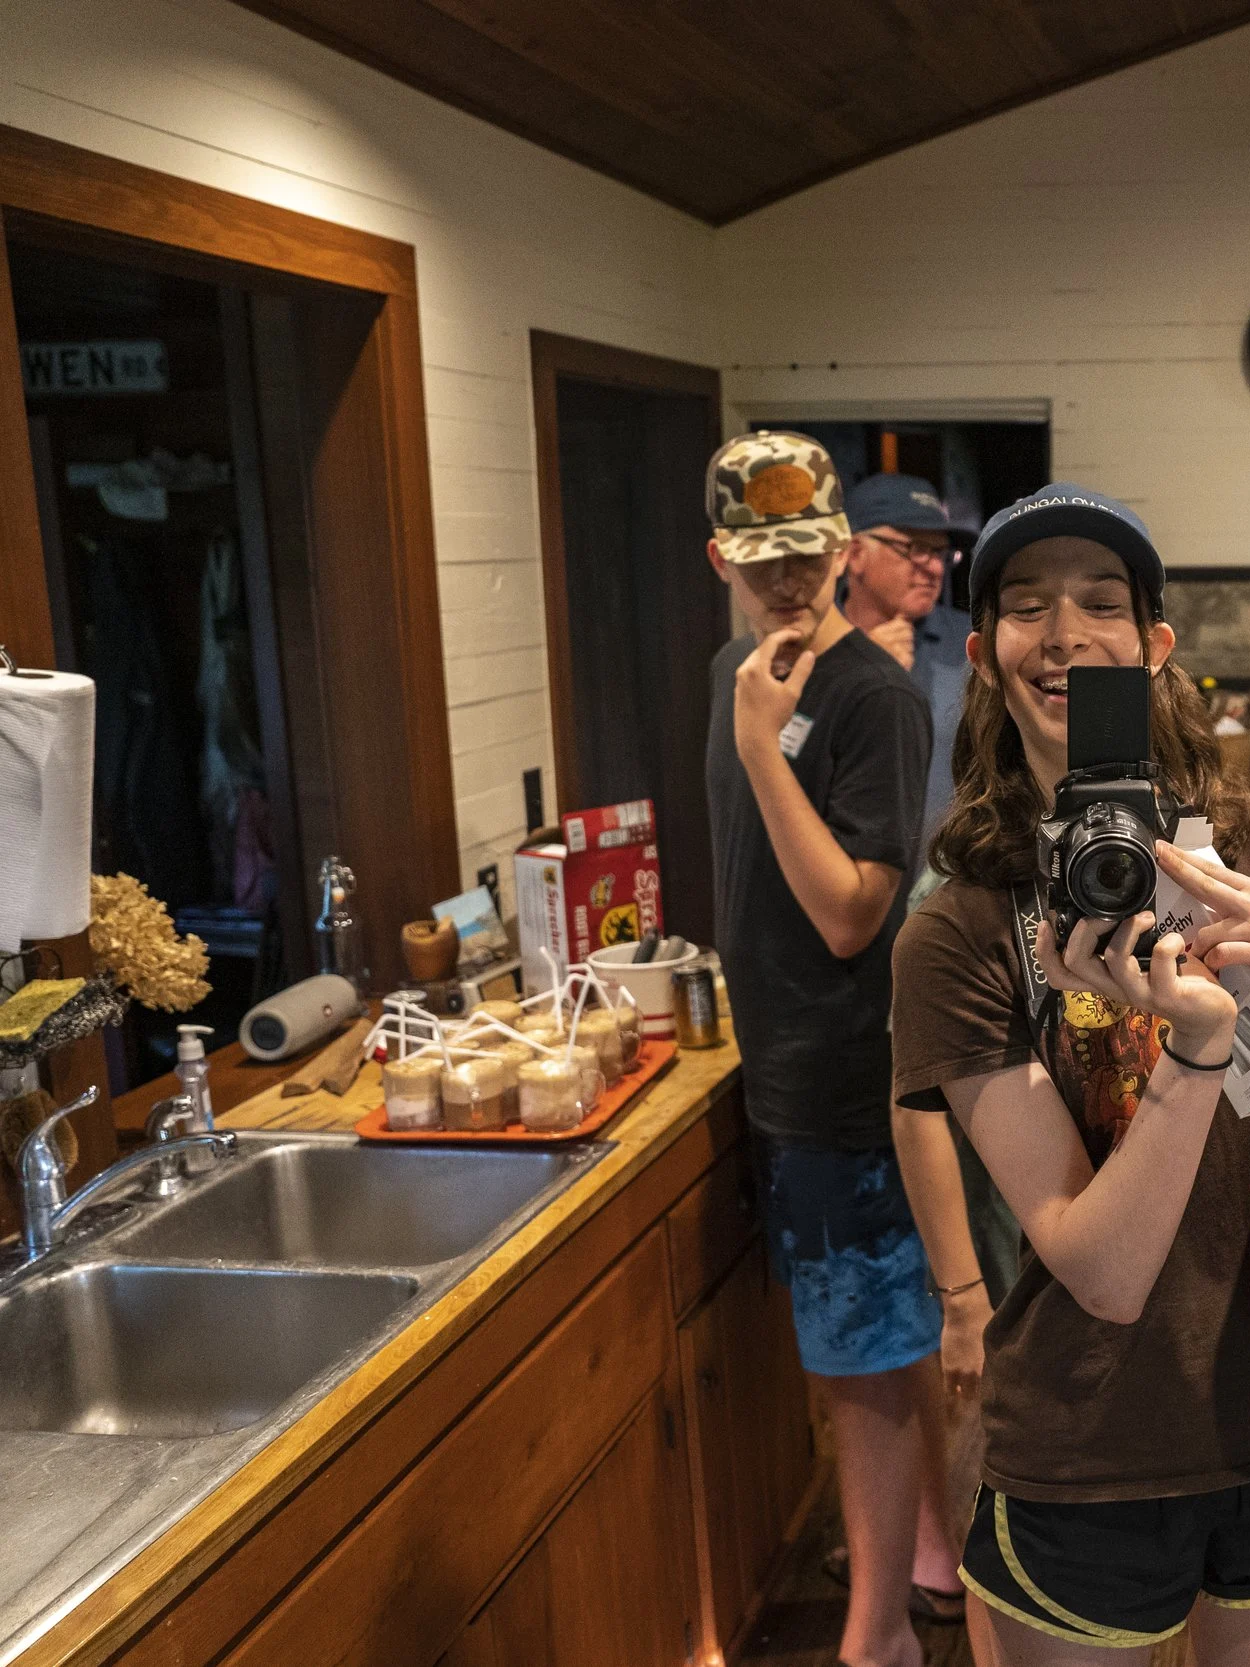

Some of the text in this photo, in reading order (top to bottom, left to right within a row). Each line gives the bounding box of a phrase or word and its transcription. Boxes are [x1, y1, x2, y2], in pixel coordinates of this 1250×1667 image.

[1051, 851, 1060, 879] Nikon
[1158, 911, 1177, 935] eal
[1169, 911, 1193, 933] rthy
